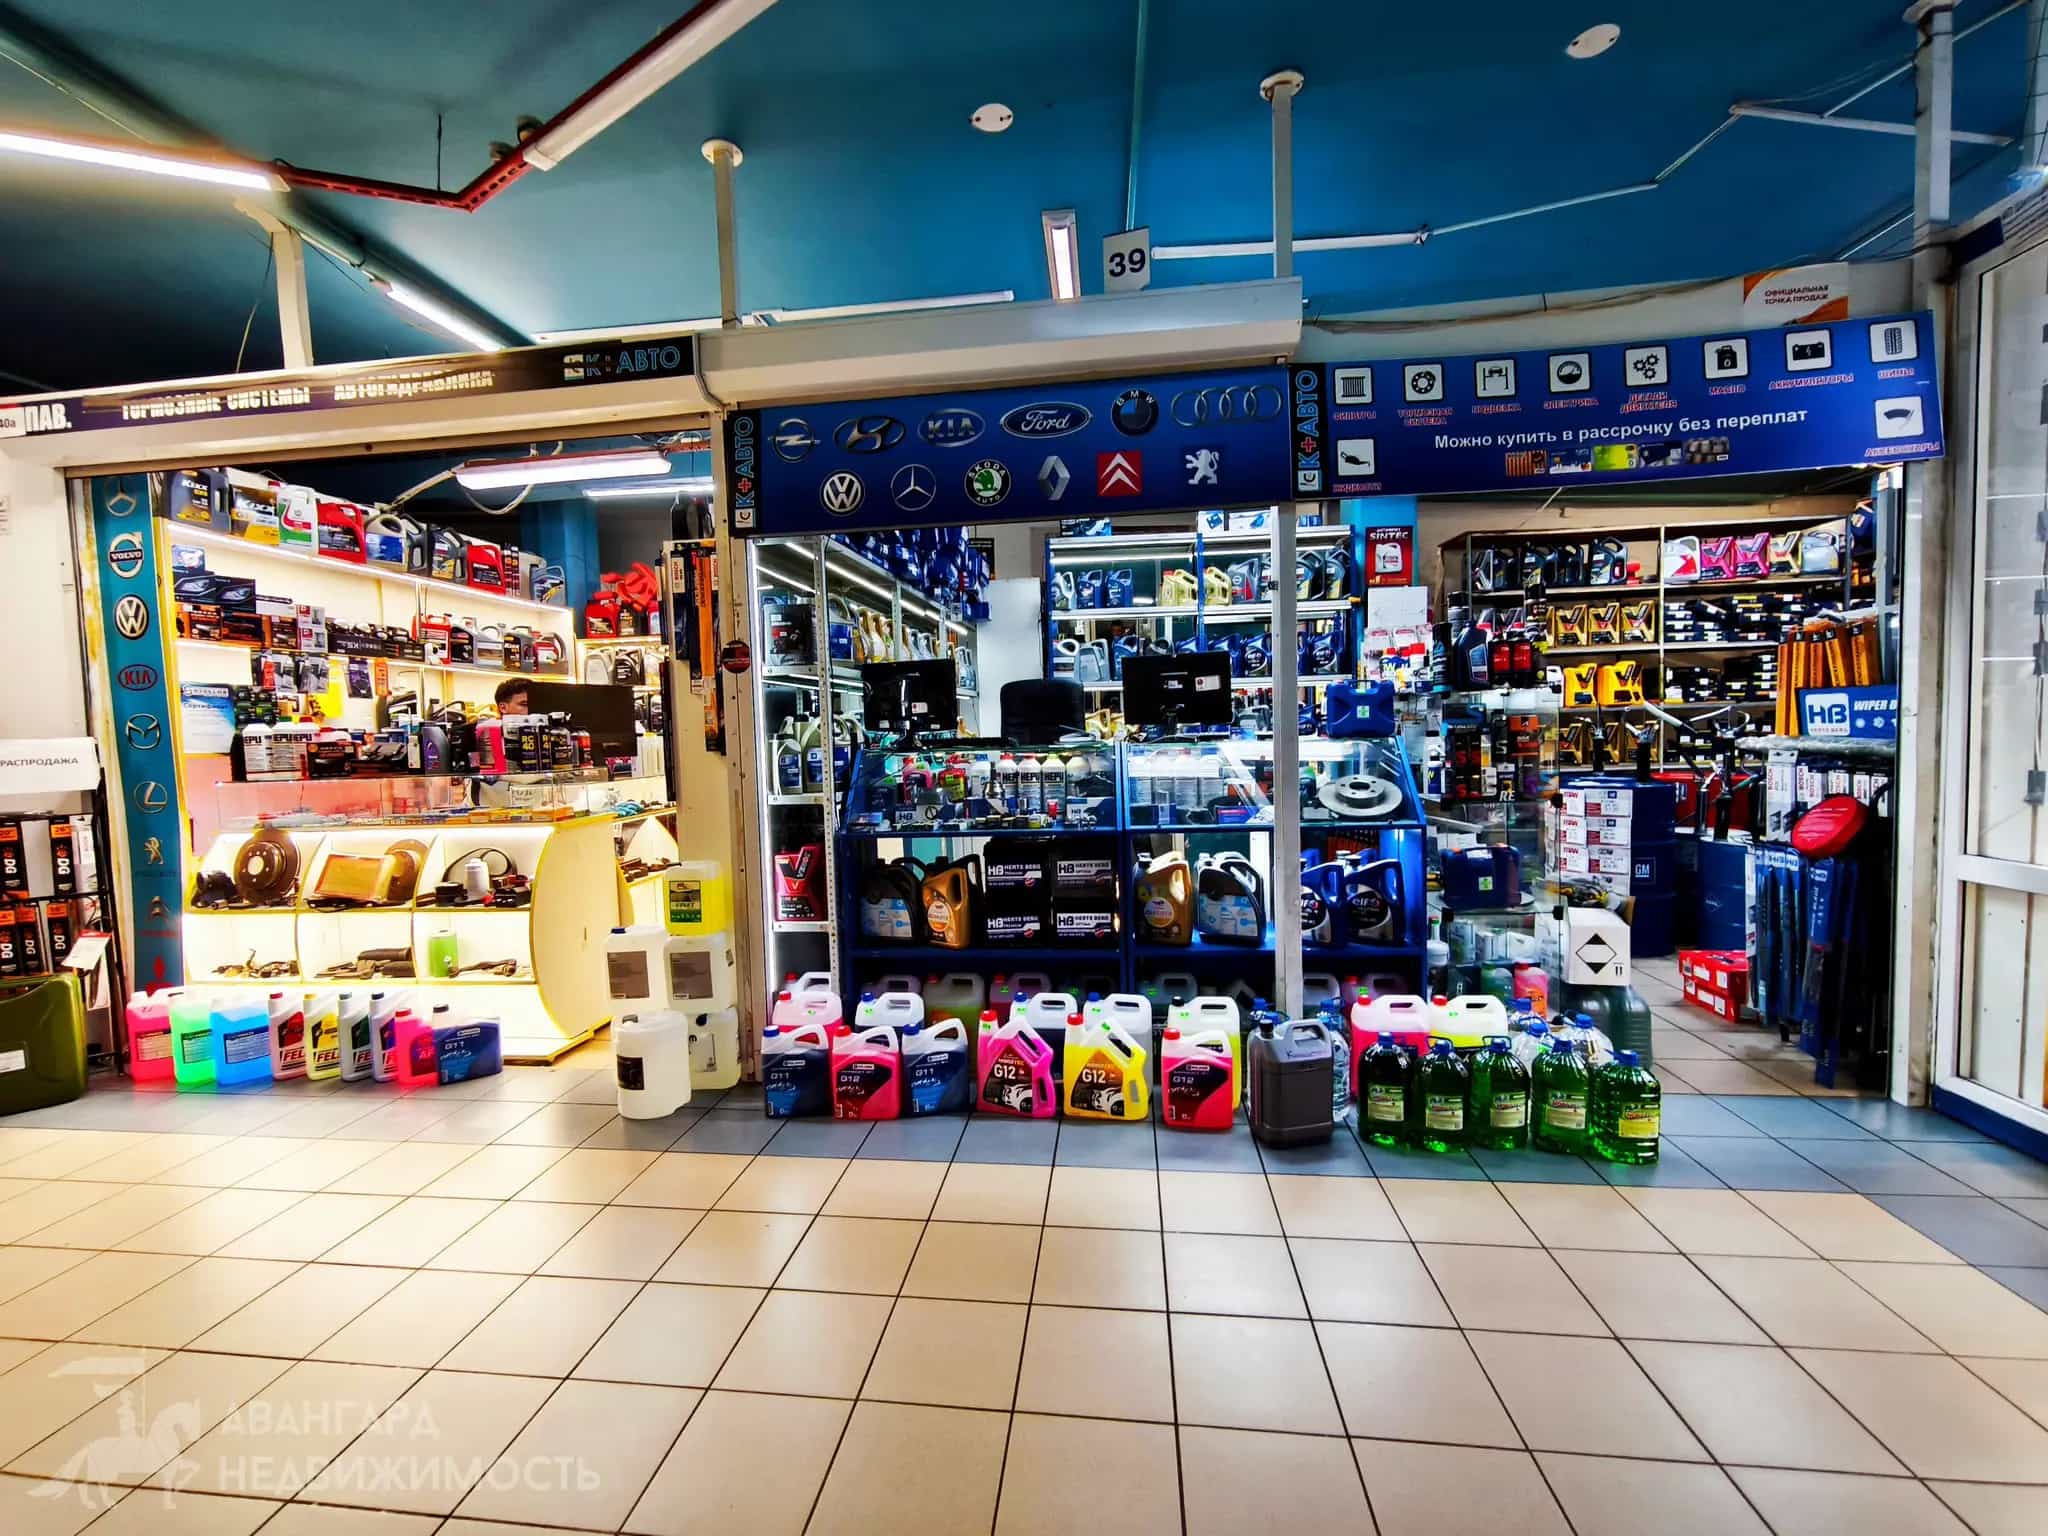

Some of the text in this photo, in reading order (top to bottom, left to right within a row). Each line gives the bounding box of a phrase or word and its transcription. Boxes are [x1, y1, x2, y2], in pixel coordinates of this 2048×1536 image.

[1108, 247, 1146, 277] 39
[1764, 284, 1830, 297] ОФИЦИАЛЬНАЯ
[1764, 293, 1830, 305] ТОЧКА ПРОДАЖ
[1115, 389, 1155, 407] BMW
[24, 402, 73, 432] ПАВ.
[1020, 408, 1073, 432] Ford
[927, 416, 977, 440] KIA
[1434, 409, 1809, 449] Можно купить в рассрочку без переплат
[1369, 531, 1409, 541] SINTEC
[111, 551, 142, 560] VOLVO
[124, 671, 152, 686] KIA
[1853, 699, 1888, 711] WIPER
[1808, 703, 1848, 724] HB
[243, 735, 262, 744] EPU
[0, 757, 79, 767] РАСПРОДАЖА
[1634, 863, 1650, 875] GM
[993, 1063, 1017, 1080] G12
[1081, 1067, 1106, 1084] G12
[1172, 1075, 1195, 1085] G12
